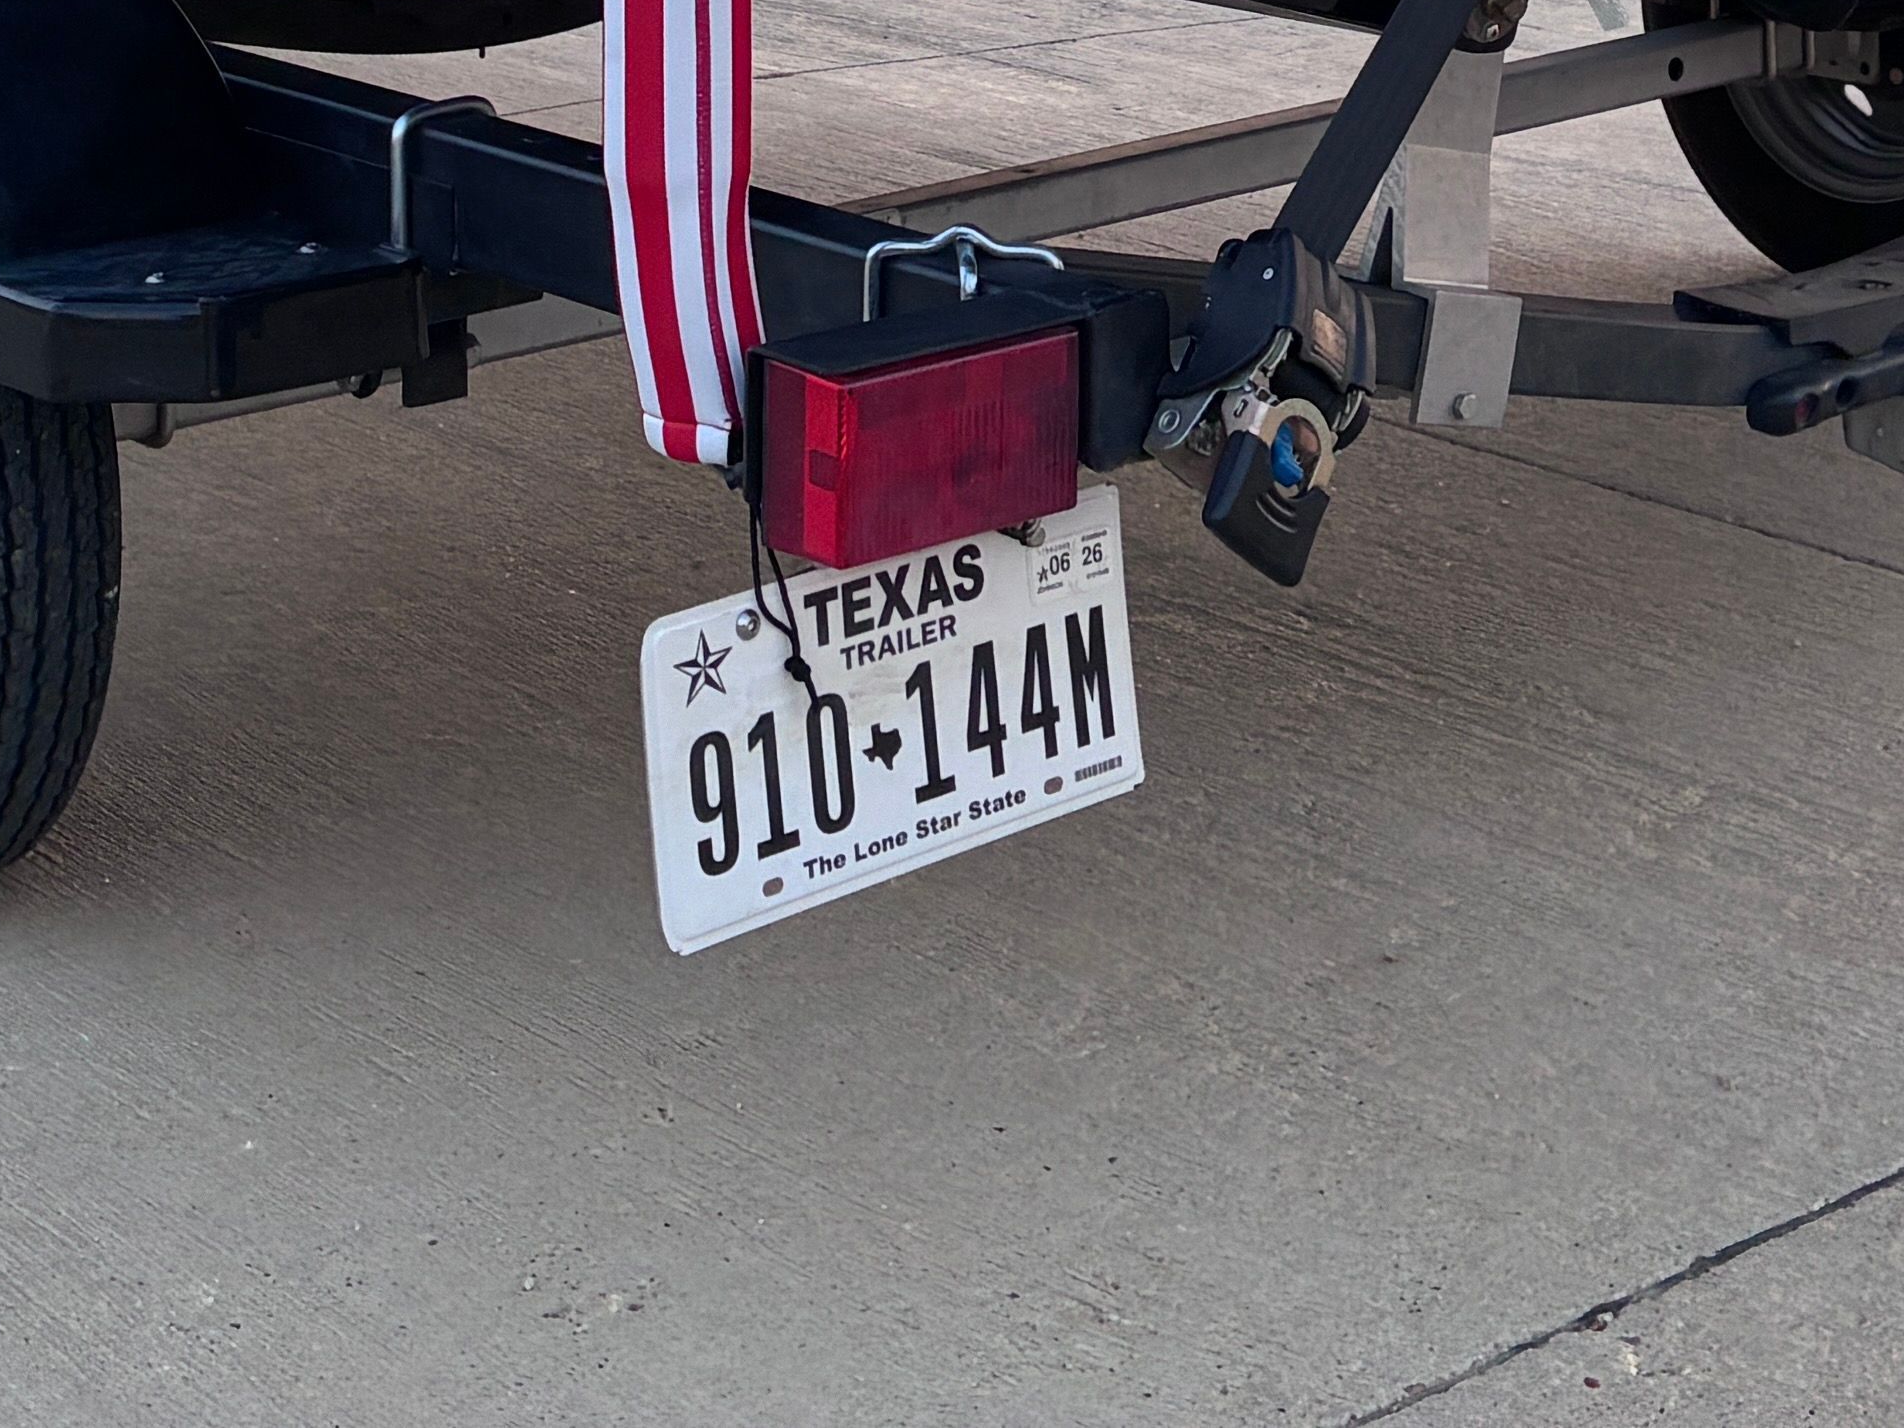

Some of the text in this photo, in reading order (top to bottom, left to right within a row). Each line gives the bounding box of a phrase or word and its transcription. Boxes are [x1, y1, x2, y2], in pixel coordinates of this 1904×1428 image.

[803, 544, 985, 647] TEXAS
[1049, 551, 1071, 576] 06
[1081, 542, 1103, 566] 26
[840, 614, 957, 671] TRAILER
[689, 604, 1116, 877] 910 144M
[803, 786, 1027, 880] The Lone Star State
